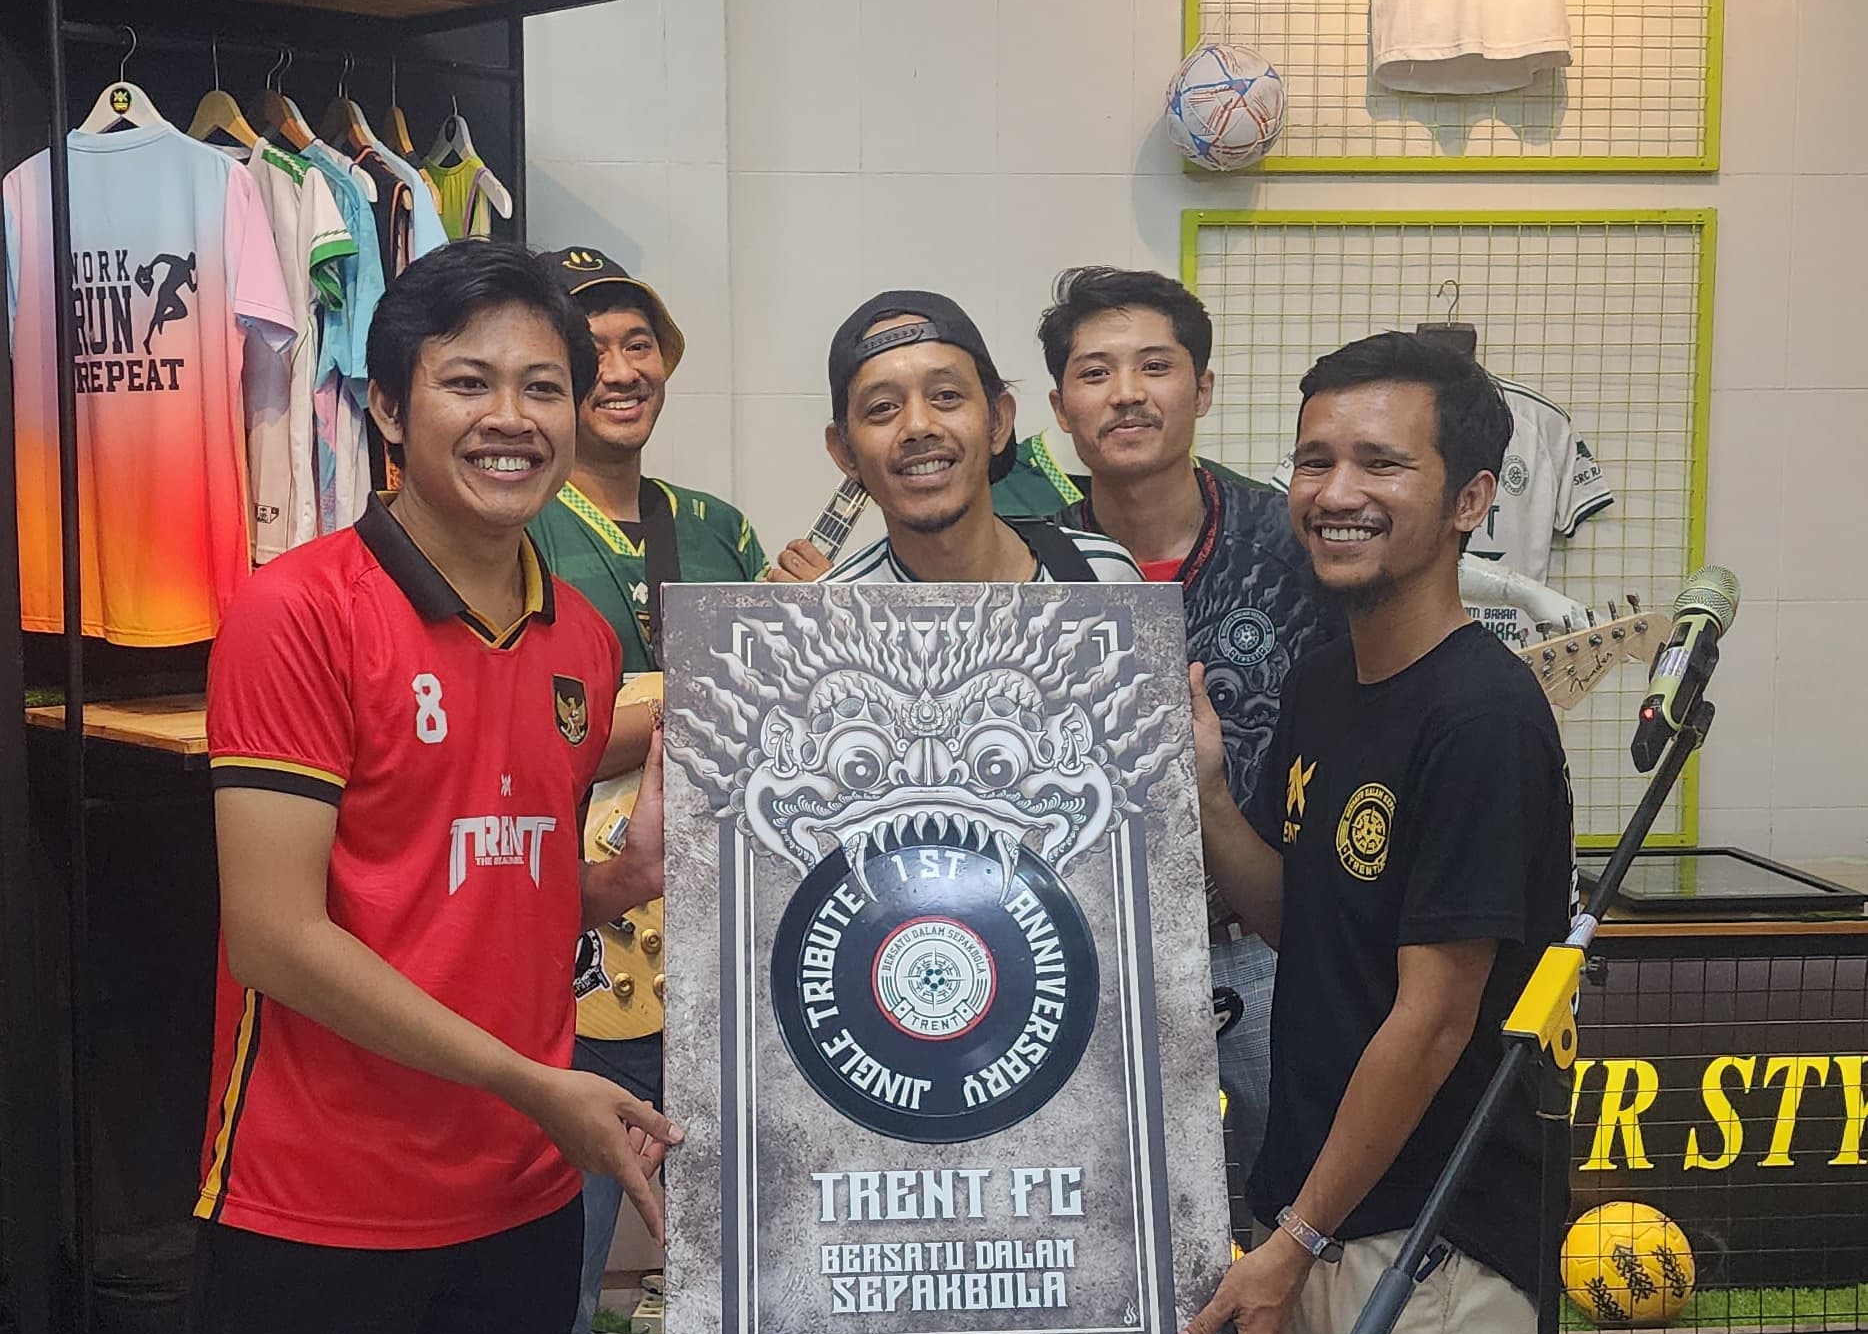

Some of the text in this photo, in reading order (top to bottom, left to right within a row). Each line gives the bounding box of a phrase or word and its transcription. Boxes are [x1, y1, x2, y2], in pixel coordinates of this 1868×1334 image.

[72, 285, 134, 355] RUN
[74, 359, 185, 393] REPEAT
[412, 673, 448, 744] 8
[449, 816, 557, 896] TRENT
[803, 882, 865, 1029] TRIBUTE
[882, 926, 987, 974] BERSATU DALAM SEPAKBOLA
[911, 1015, 959, 1031] TRENT
[962, 890, 1066, 1108] ANNIVERSARY
[821, 1028, 932, 1110] JINGLE
[810, 1167, 1085, 1222] TRENT FC
[821, 1238, 1076, 1275] BERSATU DALAM
[831, 1271, 1069, 1314] SEPAKBOLA
